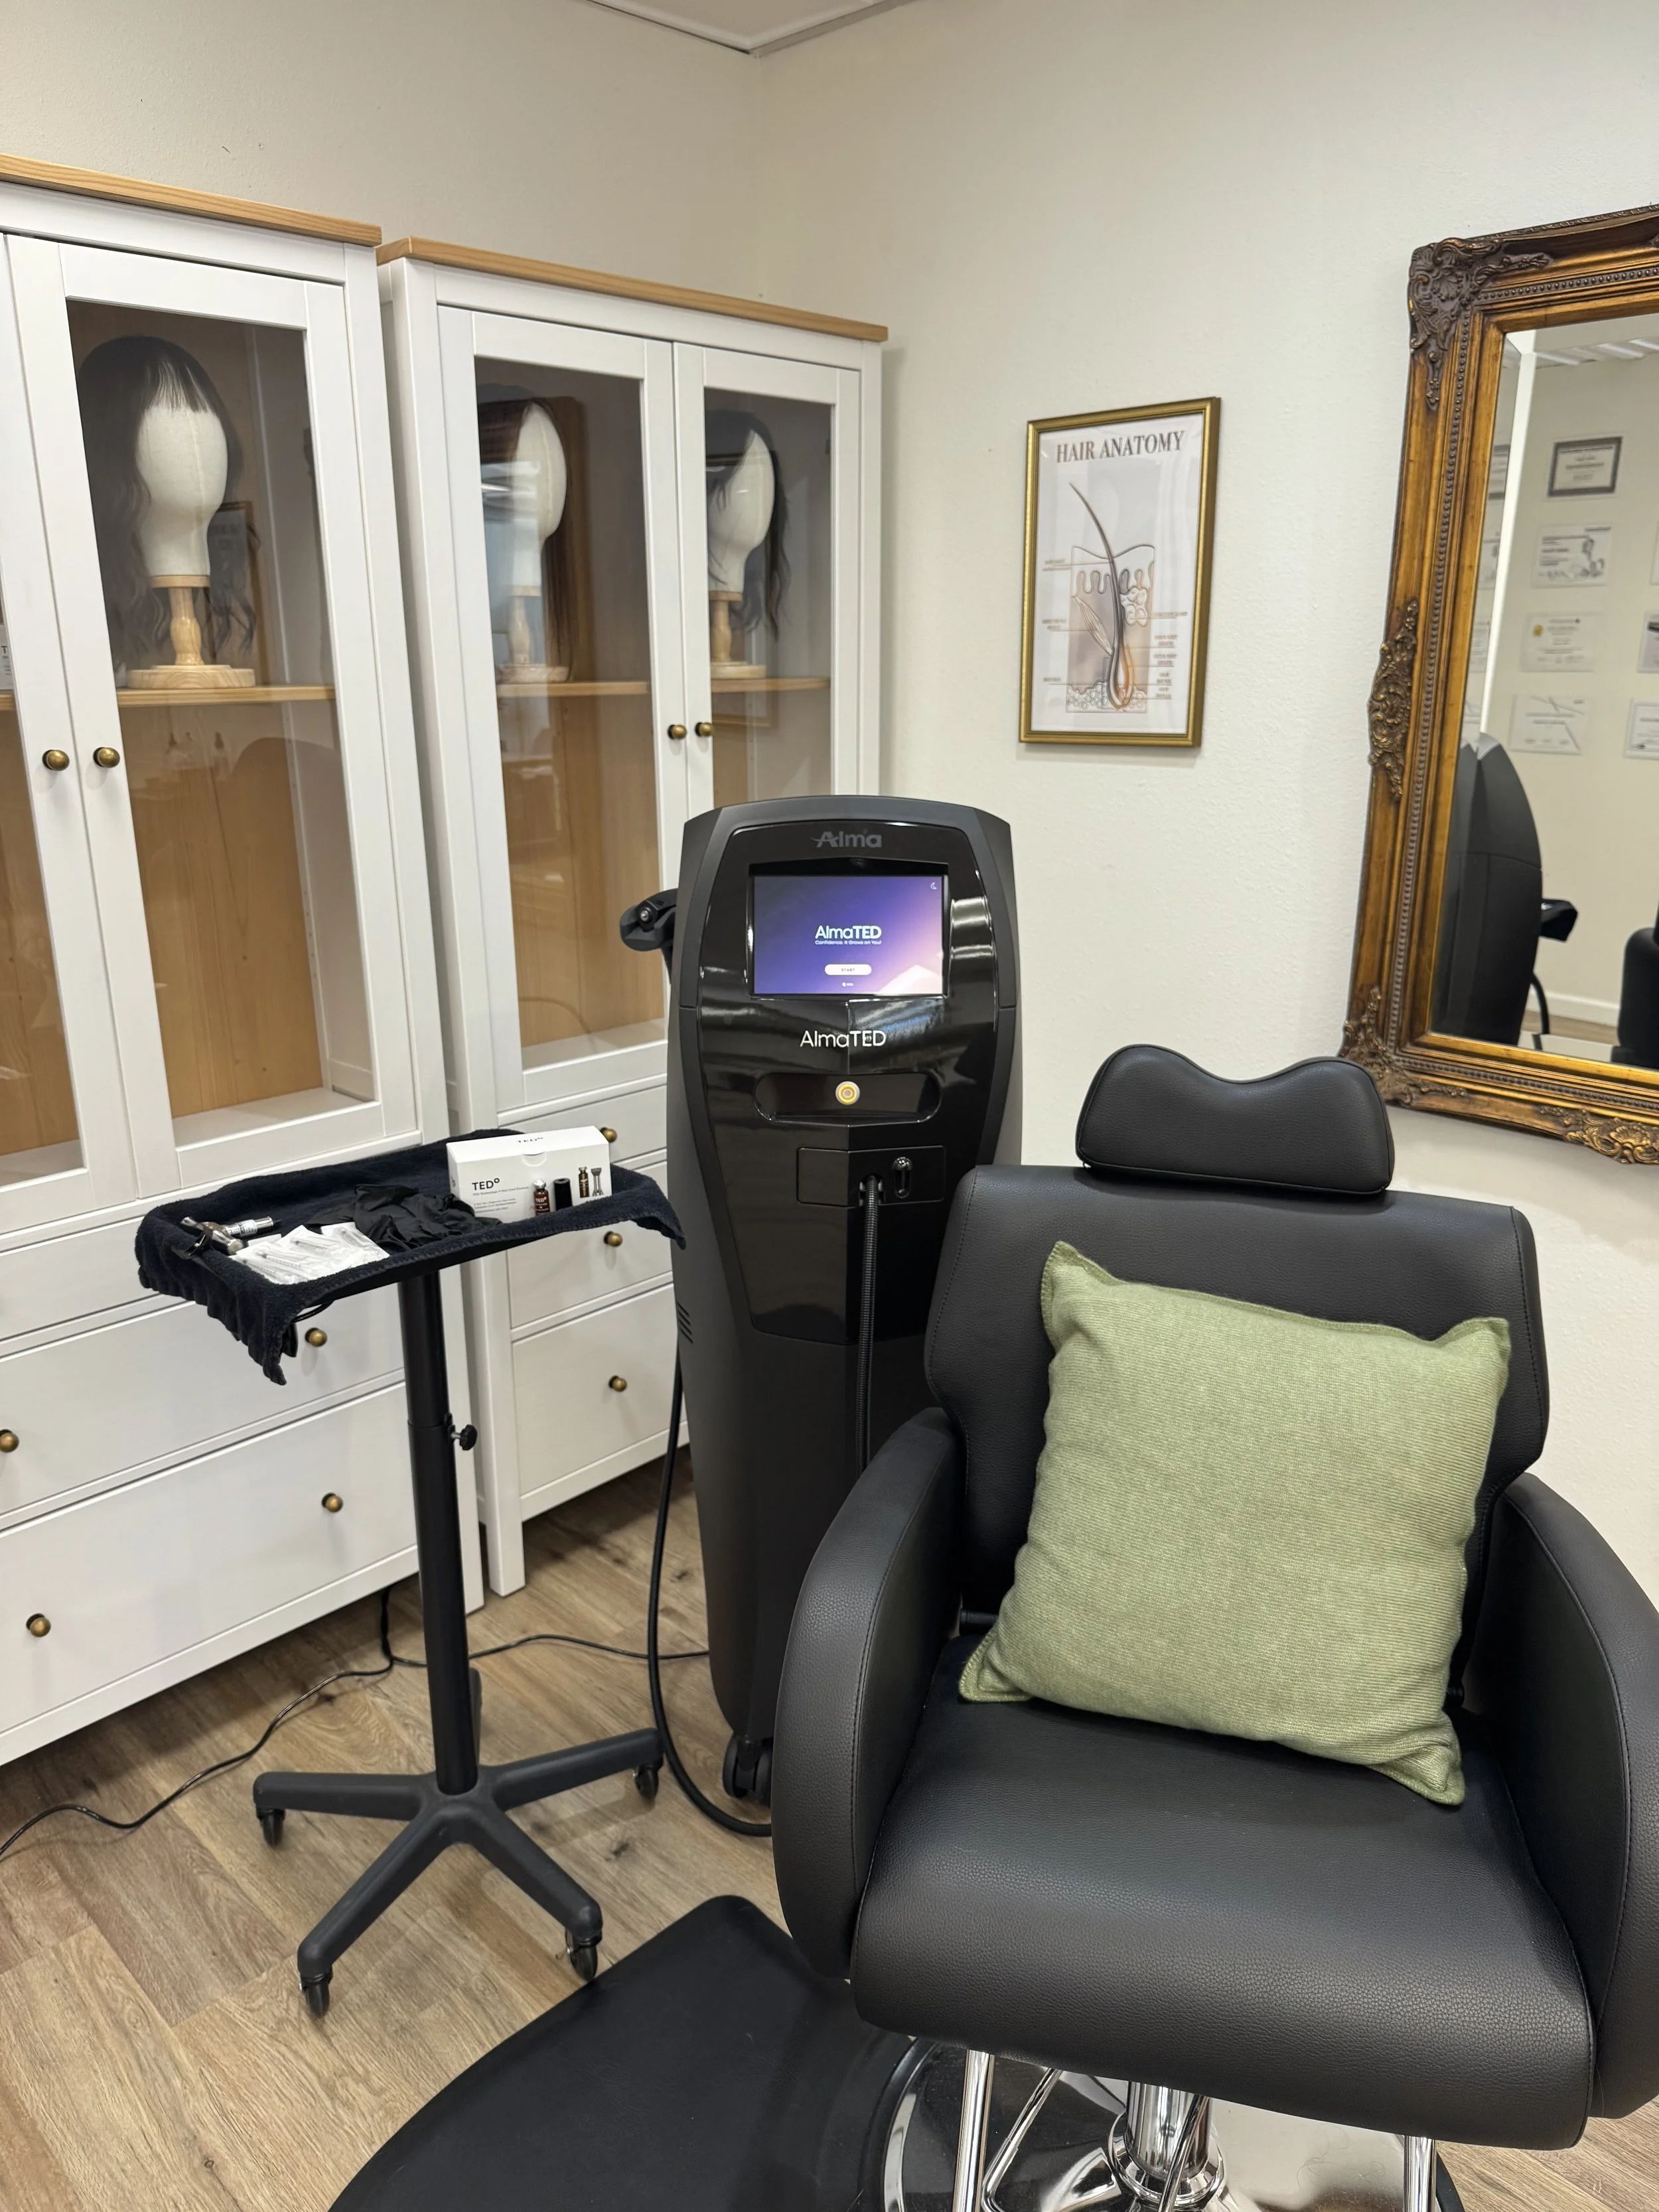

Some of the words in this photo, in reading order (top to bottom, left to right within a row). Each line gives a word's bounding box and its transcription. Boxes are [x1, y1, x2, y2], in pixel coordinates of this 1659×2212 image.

[1056, 441, 1096, 463] HAIR
[1099, 430, 1186, 459] ANATOMY
[810, 830, 883, 848] Alma
[815, 925, 882, 939] AlmaTED
[800, 1030, 887, 1048] AlmaTED
